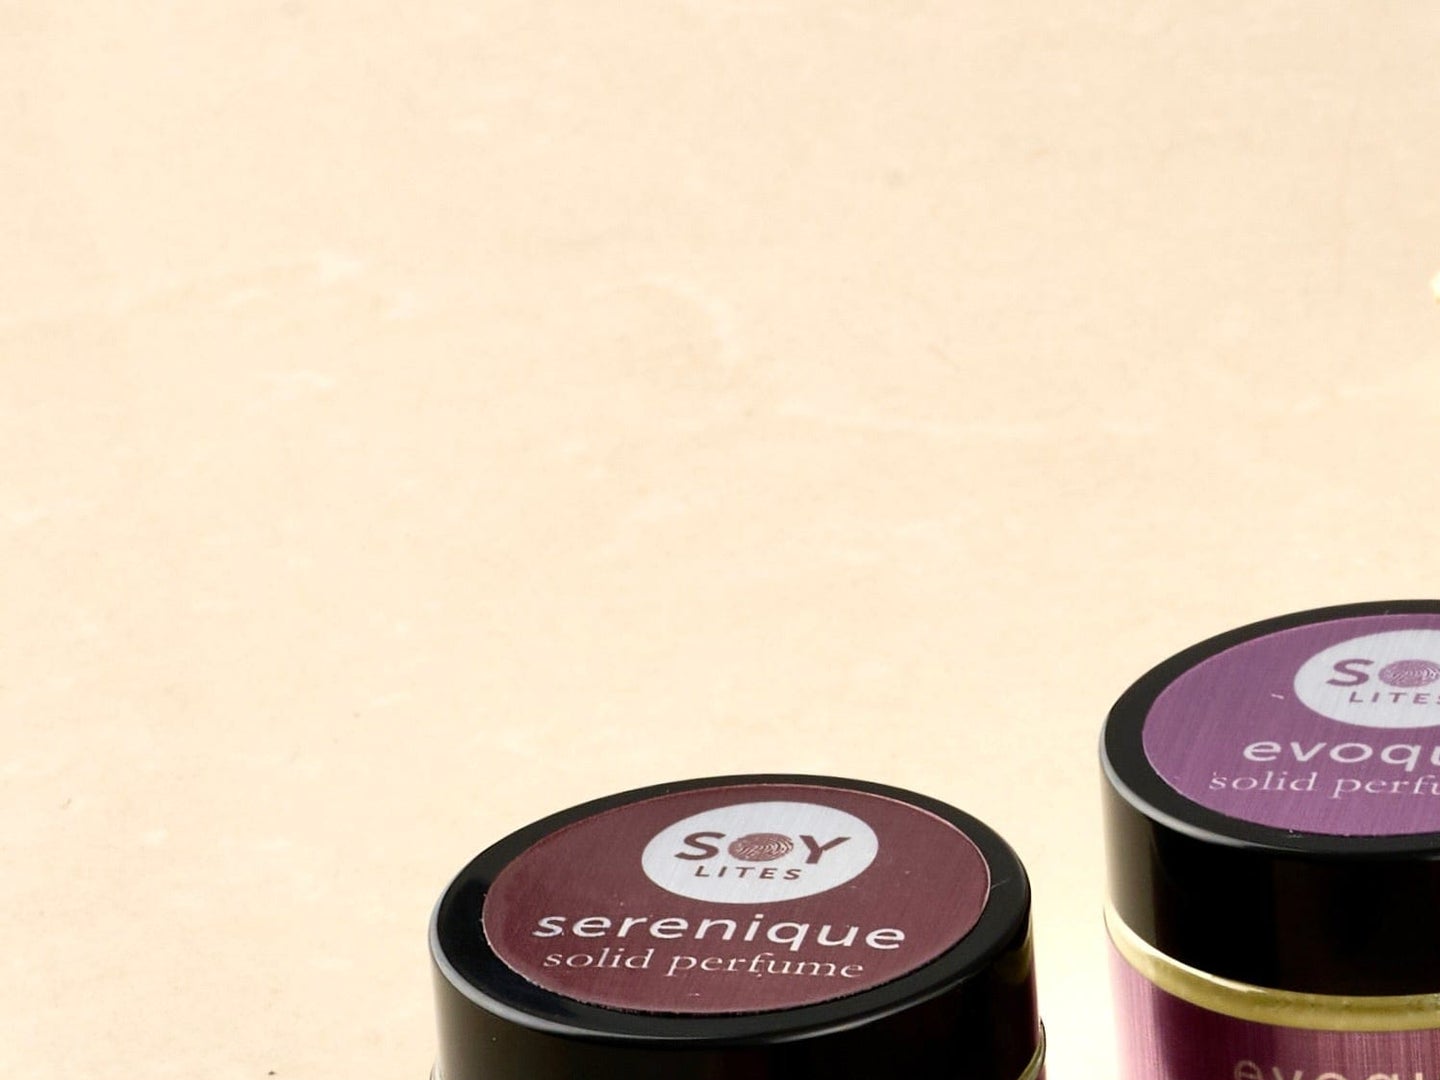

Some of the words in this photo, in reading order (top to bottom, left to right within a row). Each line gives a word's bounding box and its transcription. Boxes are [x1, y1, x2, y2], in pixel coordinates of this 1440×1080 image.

[1209, 770, 1317, 792] solid
[673, 830, 852, 864] SOY
[694, 864, 801, 881] LITES
[532, 912, 906, 951] serenique
[543, 947, 654, 970] solid
[665, 951, 864, 981] perfume
